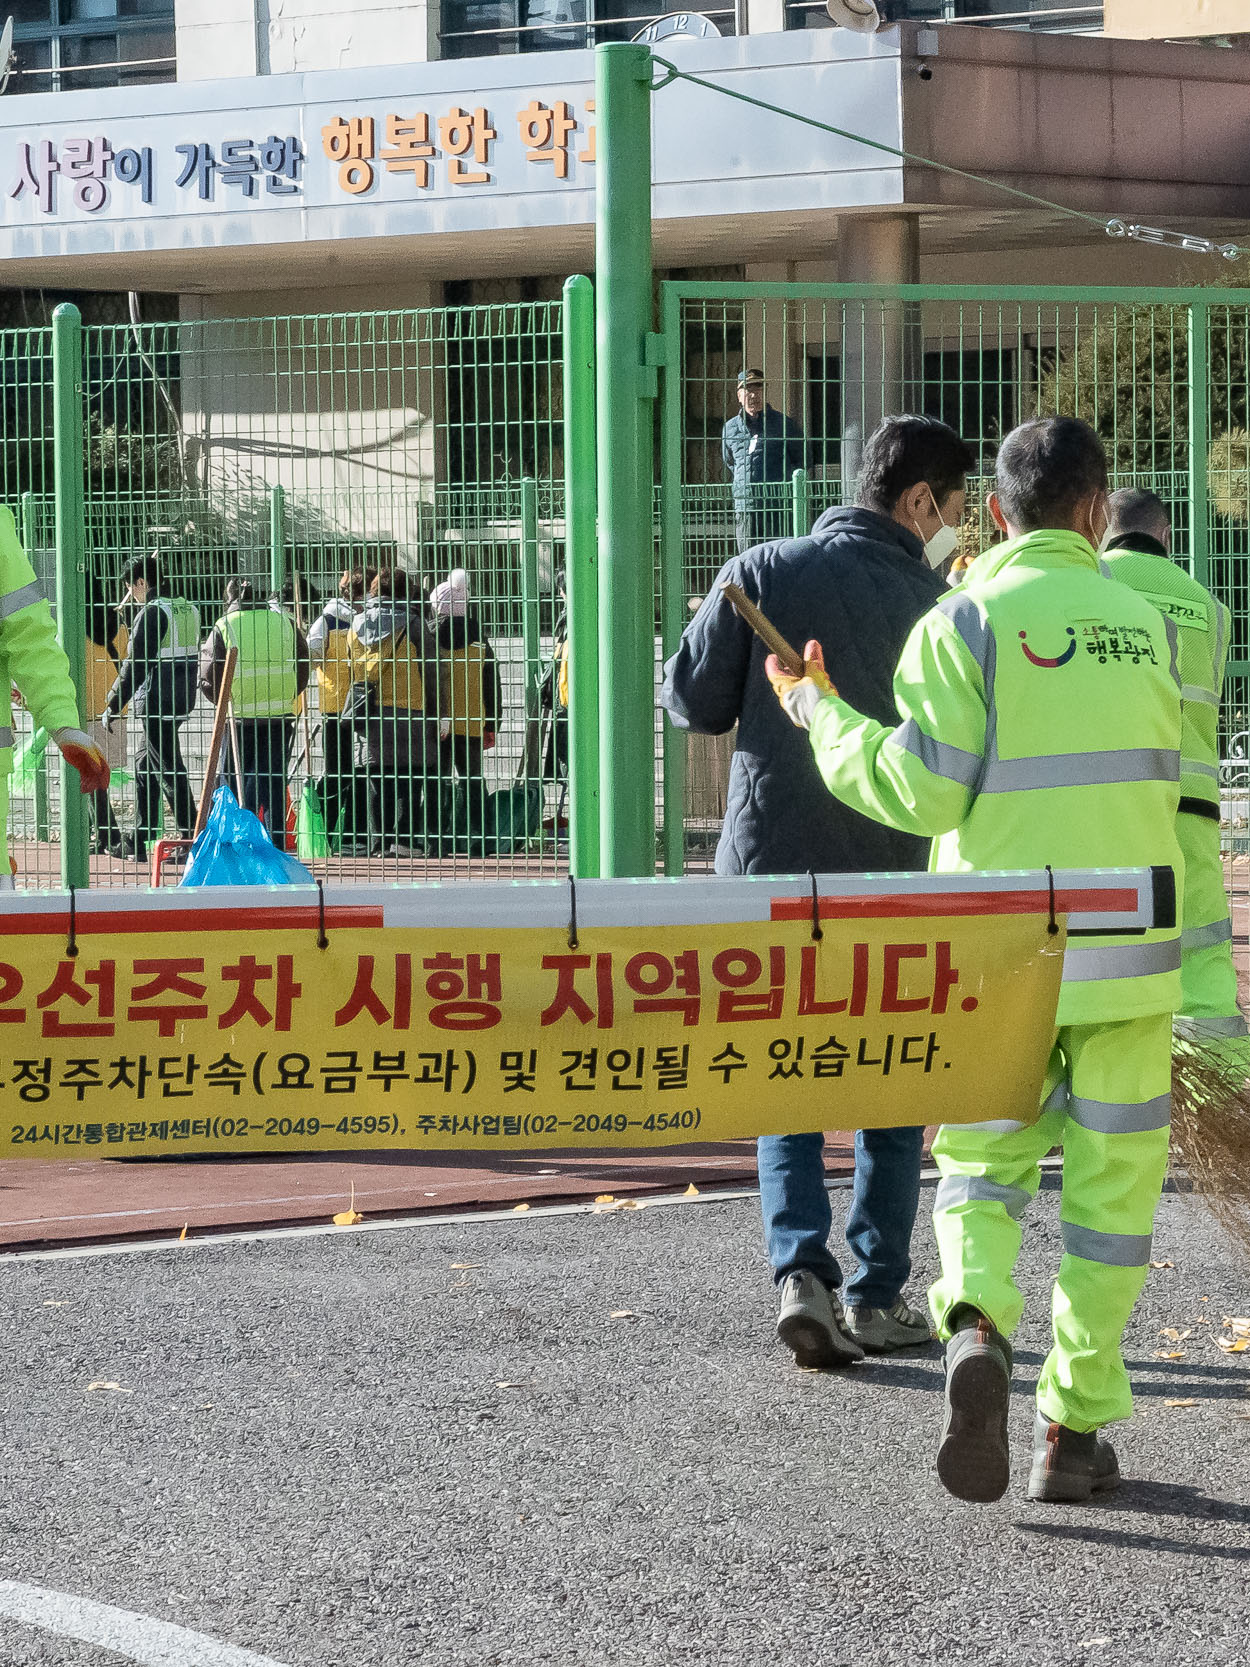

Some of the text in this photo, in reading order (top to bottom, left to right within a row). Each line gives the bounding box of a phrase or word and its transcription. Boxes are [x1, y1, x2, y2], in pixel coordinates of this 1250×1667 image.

[672, 14, 689, 31] 12
[11, 99, 595, 213] 사랑이 가득한 행복한 학
[1086, 637, 1159, 666] 행복광진
[335, 952, 502, 1031] 시행
[540, 940, 979, 1030] 지역입니다.
[0, 1030, 953, 1103] 정주차단속(요금부과) 및 견인될 수 있습니다.
[415, 1105, 702, 1137] 주차사업팀(02-2049-4540)
